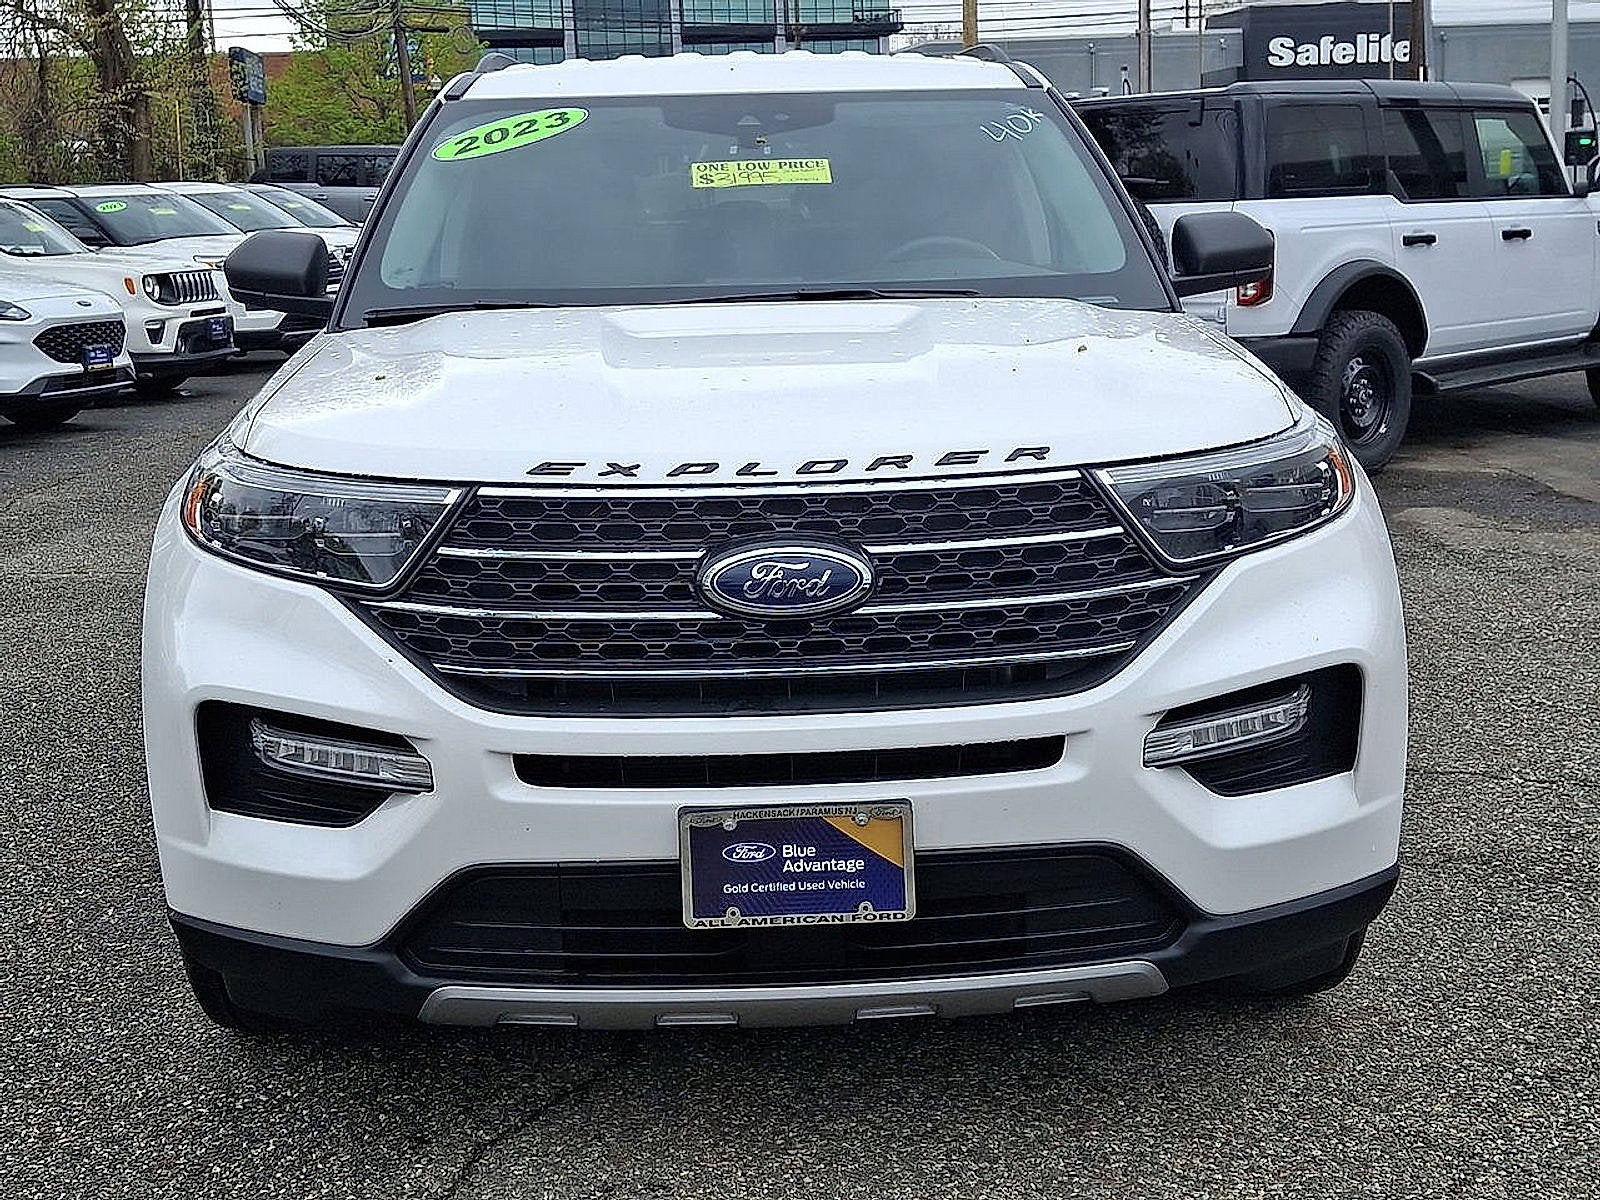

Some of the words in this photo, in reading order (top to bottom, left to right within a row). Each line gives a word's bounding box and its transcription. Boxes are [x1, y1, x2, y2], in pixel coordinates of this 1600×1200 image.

[1268, 33, 1410, 67] Safelite
[454, 111, 571, 156] 2023
[696, 163, 730, 172] ONE
[737, 162, 771, 171] LOW
[777, 160, 825, 170] PRICE
[526, 446, 1052, 478] EXPLORER
[743, 561, 832, 598] Ford
[732, 845, 765, 859] Ford
[782, 844, 817, 858] Blue
[782, 858, 865, 873] Advantage
[723, 883, 749, 894] Gold
[751, 881, 796, 893] Certified
[798, 880, 826, 891] Used
[828, 878, 866, 889] Vehicle
[694, 919, 732, 928] ALL
[737, 914, 846, 926] AMERICAN
[851, 911, 907, 922] FORD
